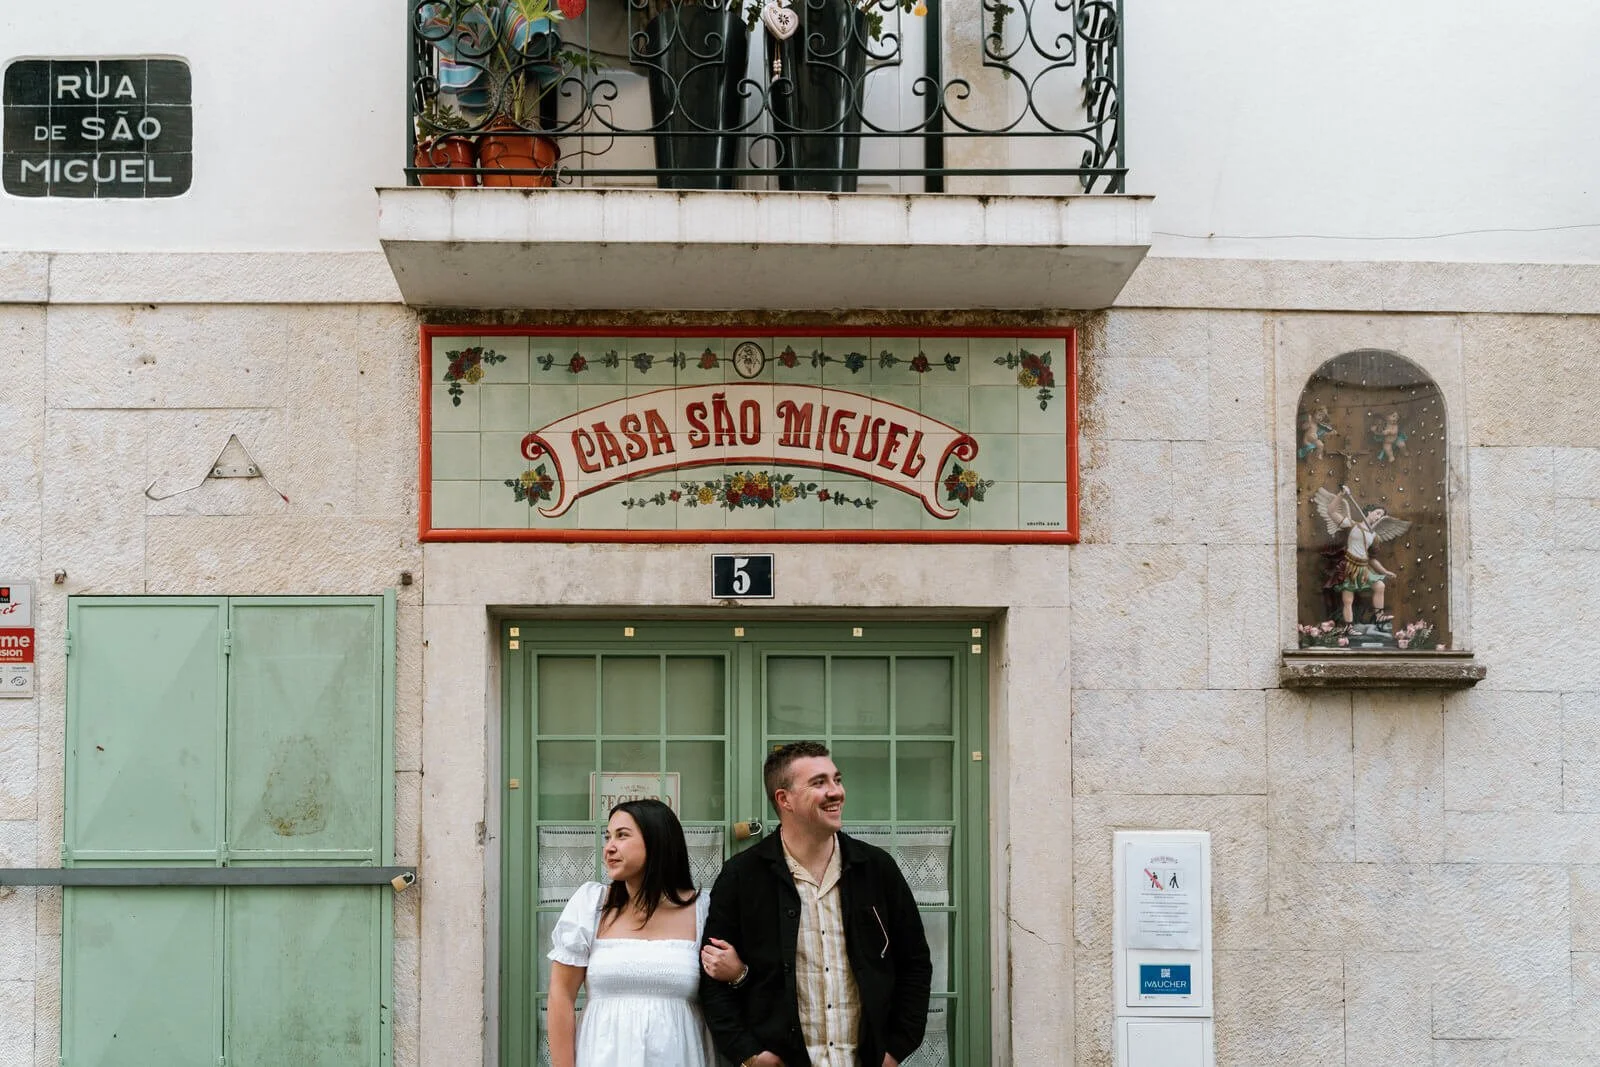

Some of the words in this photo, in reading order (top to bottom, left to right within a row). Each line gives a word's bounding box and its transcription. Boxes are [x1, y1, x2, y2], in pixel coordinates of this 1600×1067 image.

[57, 74, 137, 99] RUA
[34, 125, 67, 141] DE
[81, 110, 162, 141] SÃO
[20, 159, 173, 183] MIGUEL
[571, 408, 676, 474] CASA
[686, 392, 761, 449] SÃO
[776, 400, 926, 479] MIGUEL
[733, 558, 751, 595] 5
[1144, 980, 1187, 988] IVAUCHER
